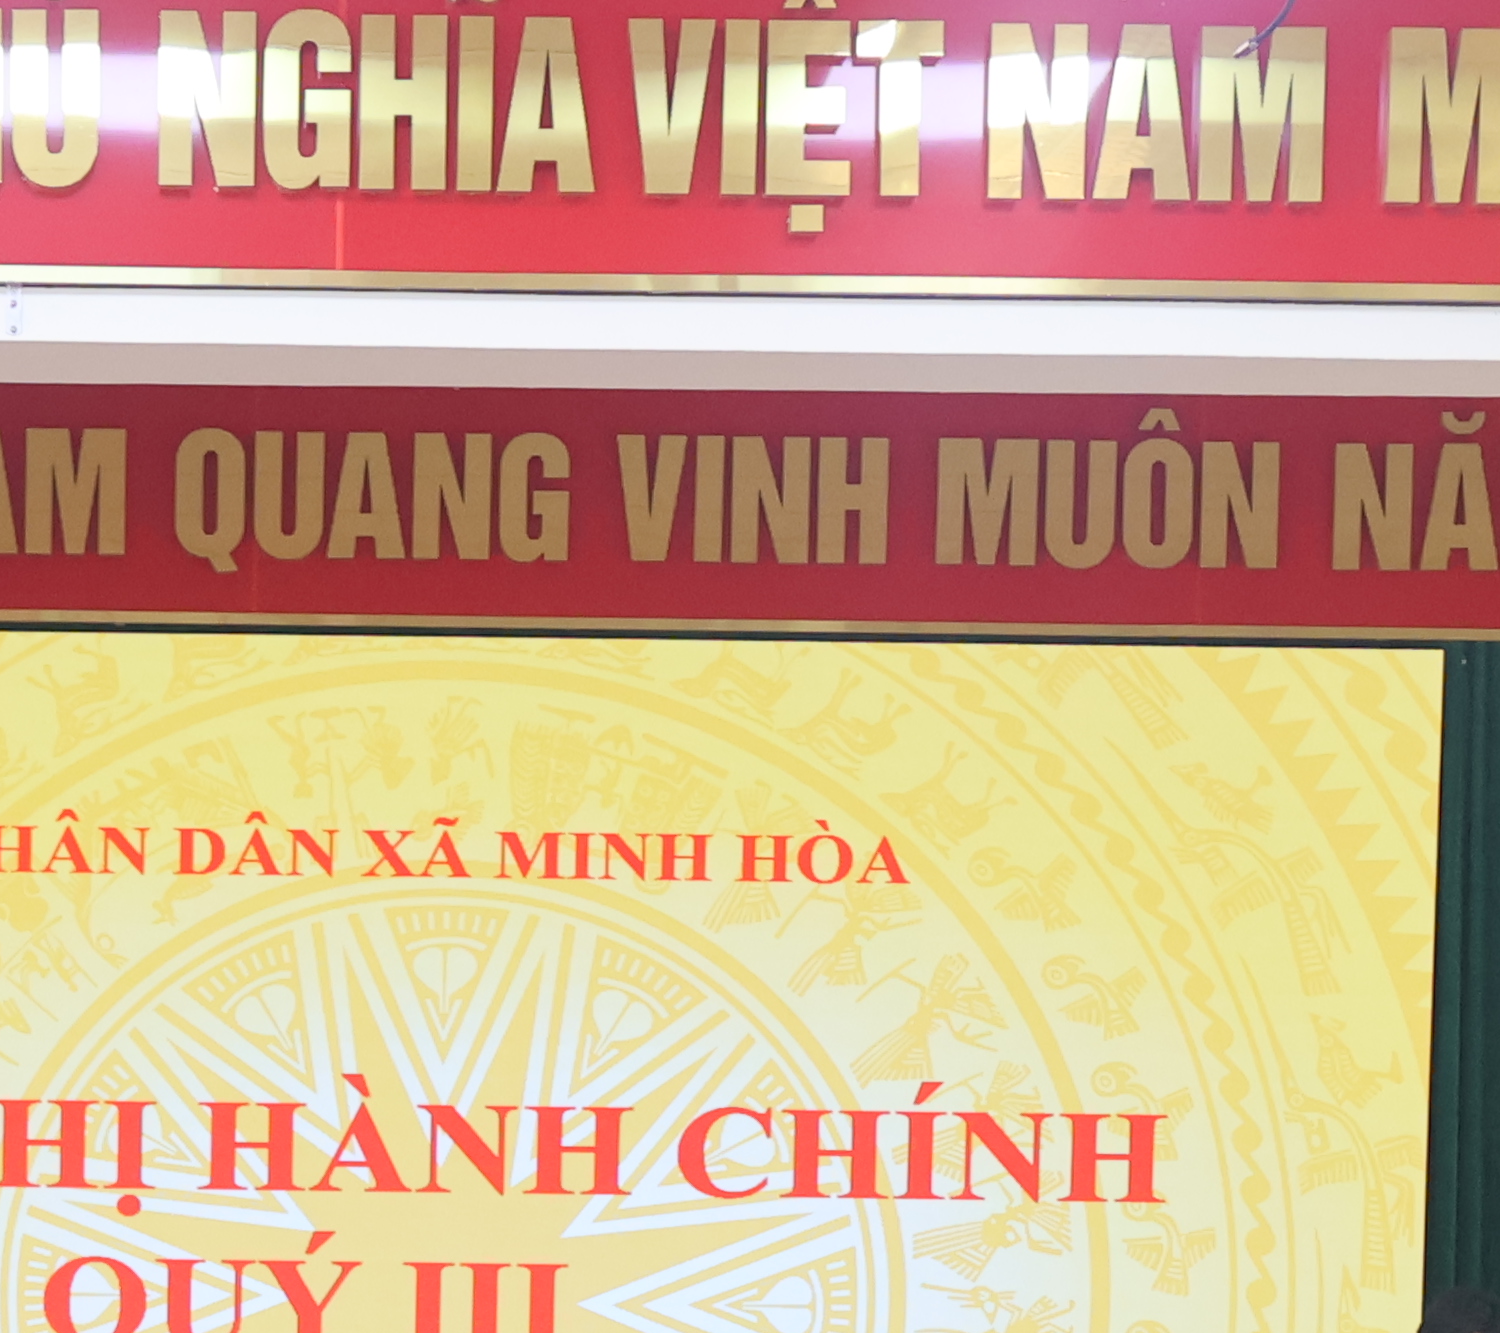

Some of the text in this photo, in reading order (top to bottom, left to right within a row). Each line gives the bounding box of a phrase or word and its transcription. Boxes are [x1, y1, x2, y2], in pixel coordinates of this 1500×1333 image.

[627, 0, 946, 234] VIỆT
[987, 22, 1327, 203] NAM
[174, 427, 571, 573] QUANG
[616, 434, 890, 566] VINH
[934, 408, 1281, 570] MUÔN
[178, 811, 337, 875] DÂN
[364, 817, 470, 877] XÃ
[498, 832, 710, 880] MINH
[740, 820, 908, 884] HÒA
[202, 1074, 632, 1195] HÀNH
[679, 1082, 1166, 1203] CHÍNH
